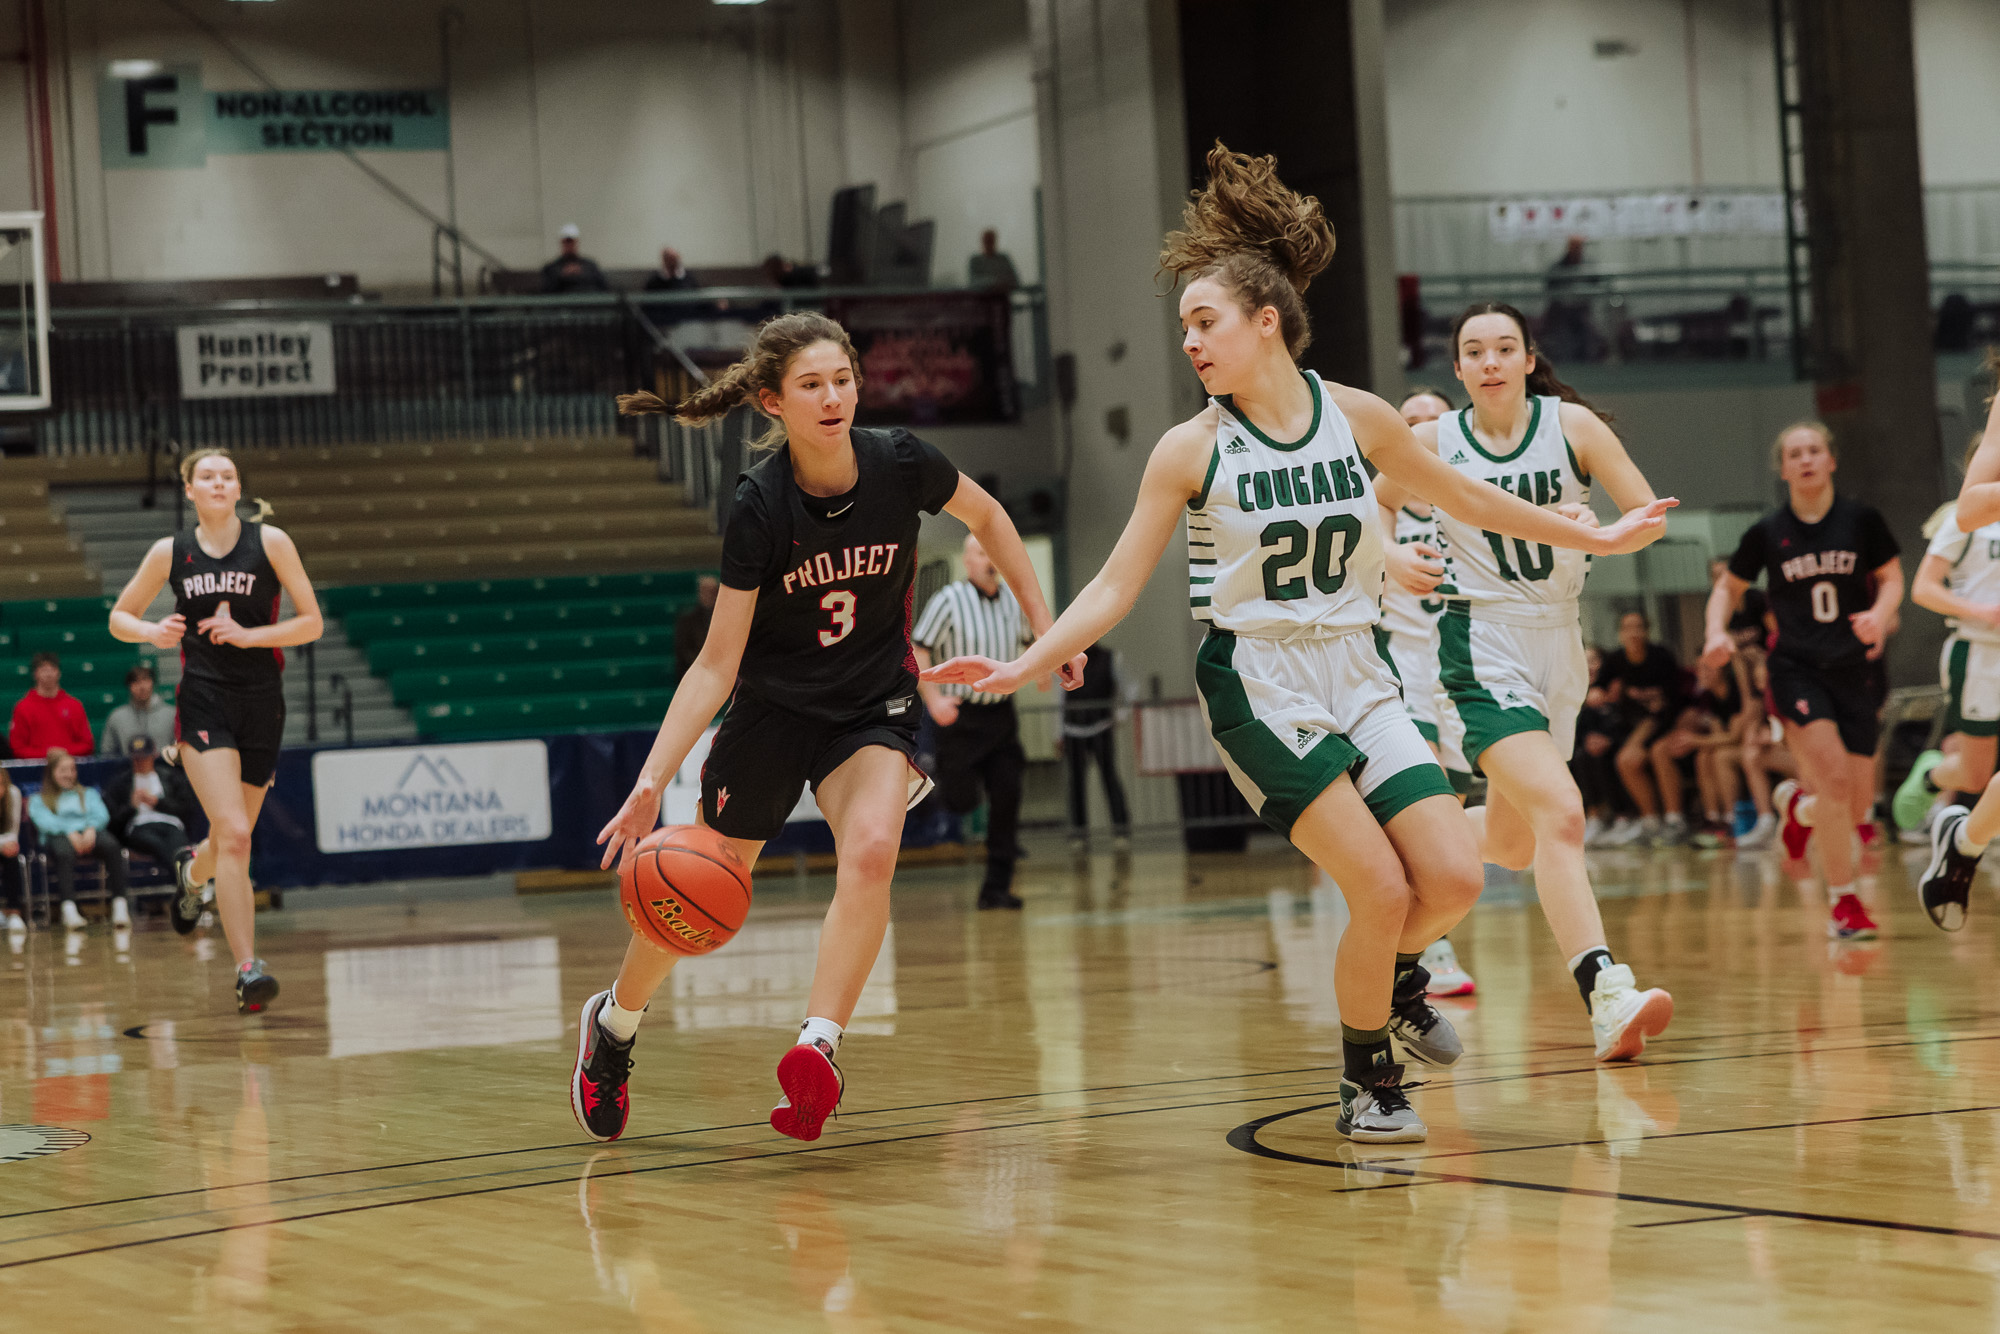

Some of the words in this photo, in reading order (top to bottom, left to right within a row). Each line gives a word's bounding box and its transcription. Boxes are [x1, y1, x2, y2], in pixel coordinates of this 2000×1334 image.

[125, 75, 178, 155] F
[216, 92, 434, 119] NON-ALCOHOL
[261, 121, 394, 148] SECTION
[199, 333, 311, 359] Huntley
[200, 360, 312, 387] Project
[1237, 454, 1365, 513] COUGARS
[782, 543, 899, 595] PROJECT
[1259, 513, 1362, 602] 20
[1781, 550, 1858, 583] PROJECT
[182, 570, 256, 600] PROJECT
[818, 589, 858, 648] 3
[1811, 581, 1840, 624] 0
[363, 790, 504, 818] MONTANA
[338, 823, 425, 844] HONDA
[431, 816, 532, 841] DEALERS
[649, 897, 721, 949] Baden
